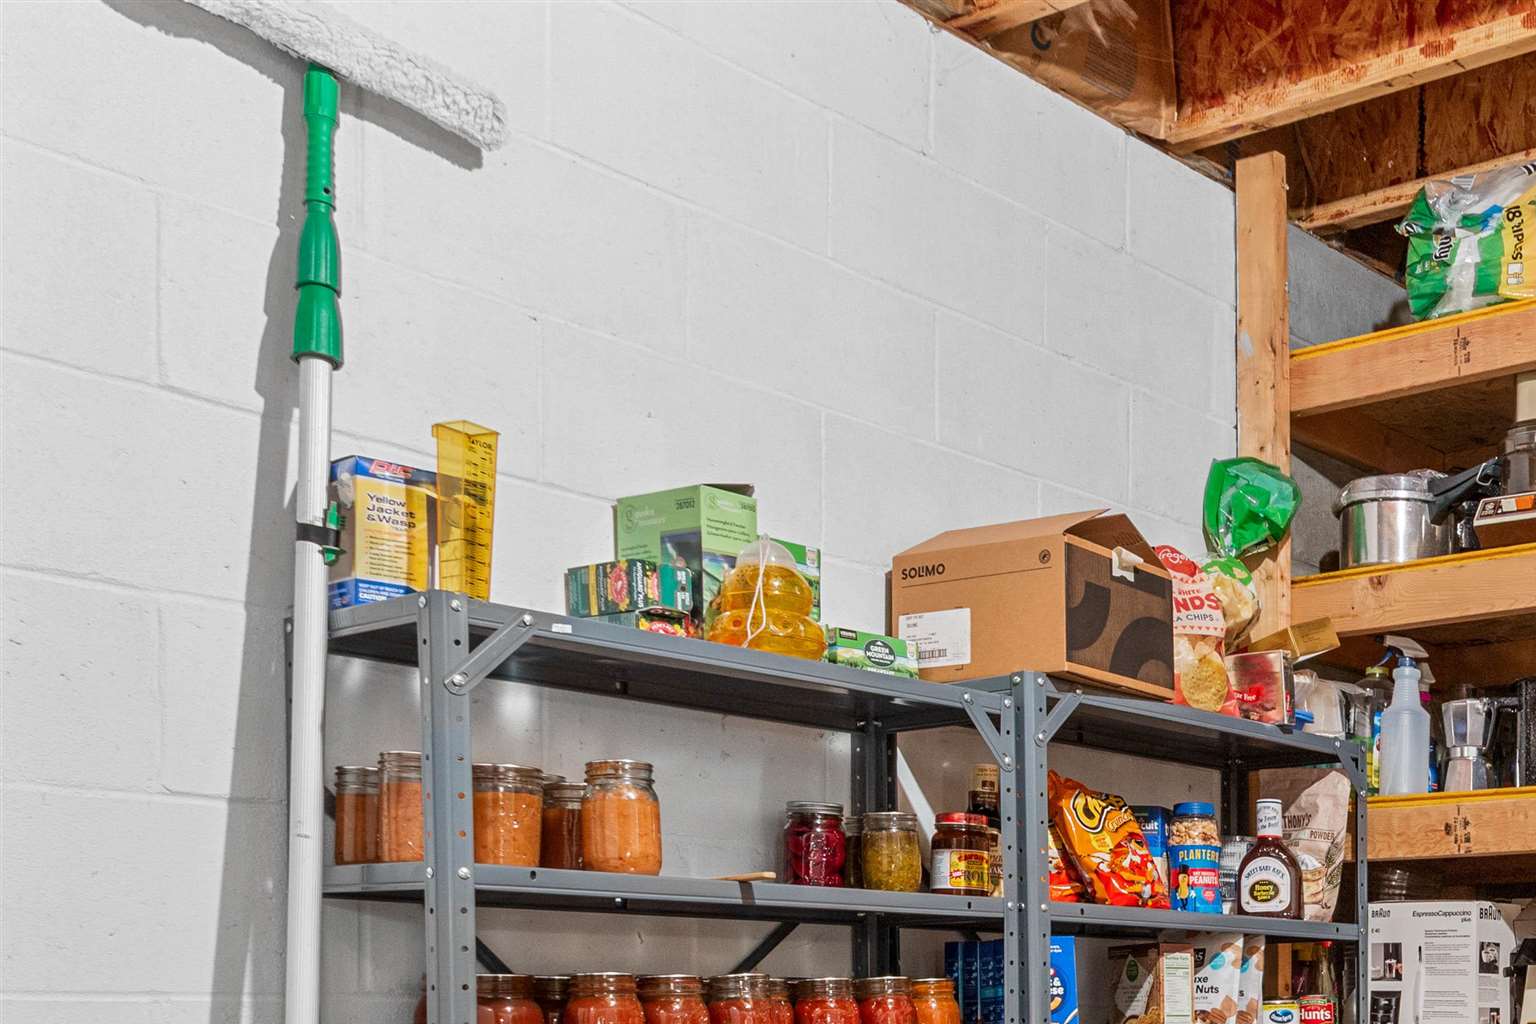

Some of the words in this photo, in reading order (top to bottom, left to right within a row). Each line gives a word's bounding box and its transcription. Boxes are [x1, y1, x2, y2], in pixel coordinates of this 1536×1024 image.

[1506, 205, 1523, 222] 18
[367, 493, 407, 508] Yellow
[367, 505, 416, 519] Jacket
[901, 563, 946, 581] SOLIMO
[1186, 613, 1214, 622] CHIPS
[869, 645, 890, 654] GREEN
[866, 651, 895, 661] MOUNTAIN
[1244, 692, 1257, 701] Free
[1310, 829, 1335, 840] POWDER
[1245, 866, 1259, 880] SWEET
[1259, 864, 1272, 872] BABY
[1372, 908, 1390, 918] BRAUN
[1412, 910, 1472, 918] EspressoCappuccino
[1480, 906, 1501, 921] BRAUN
[1196, 985, 1219, 994] Nuts
